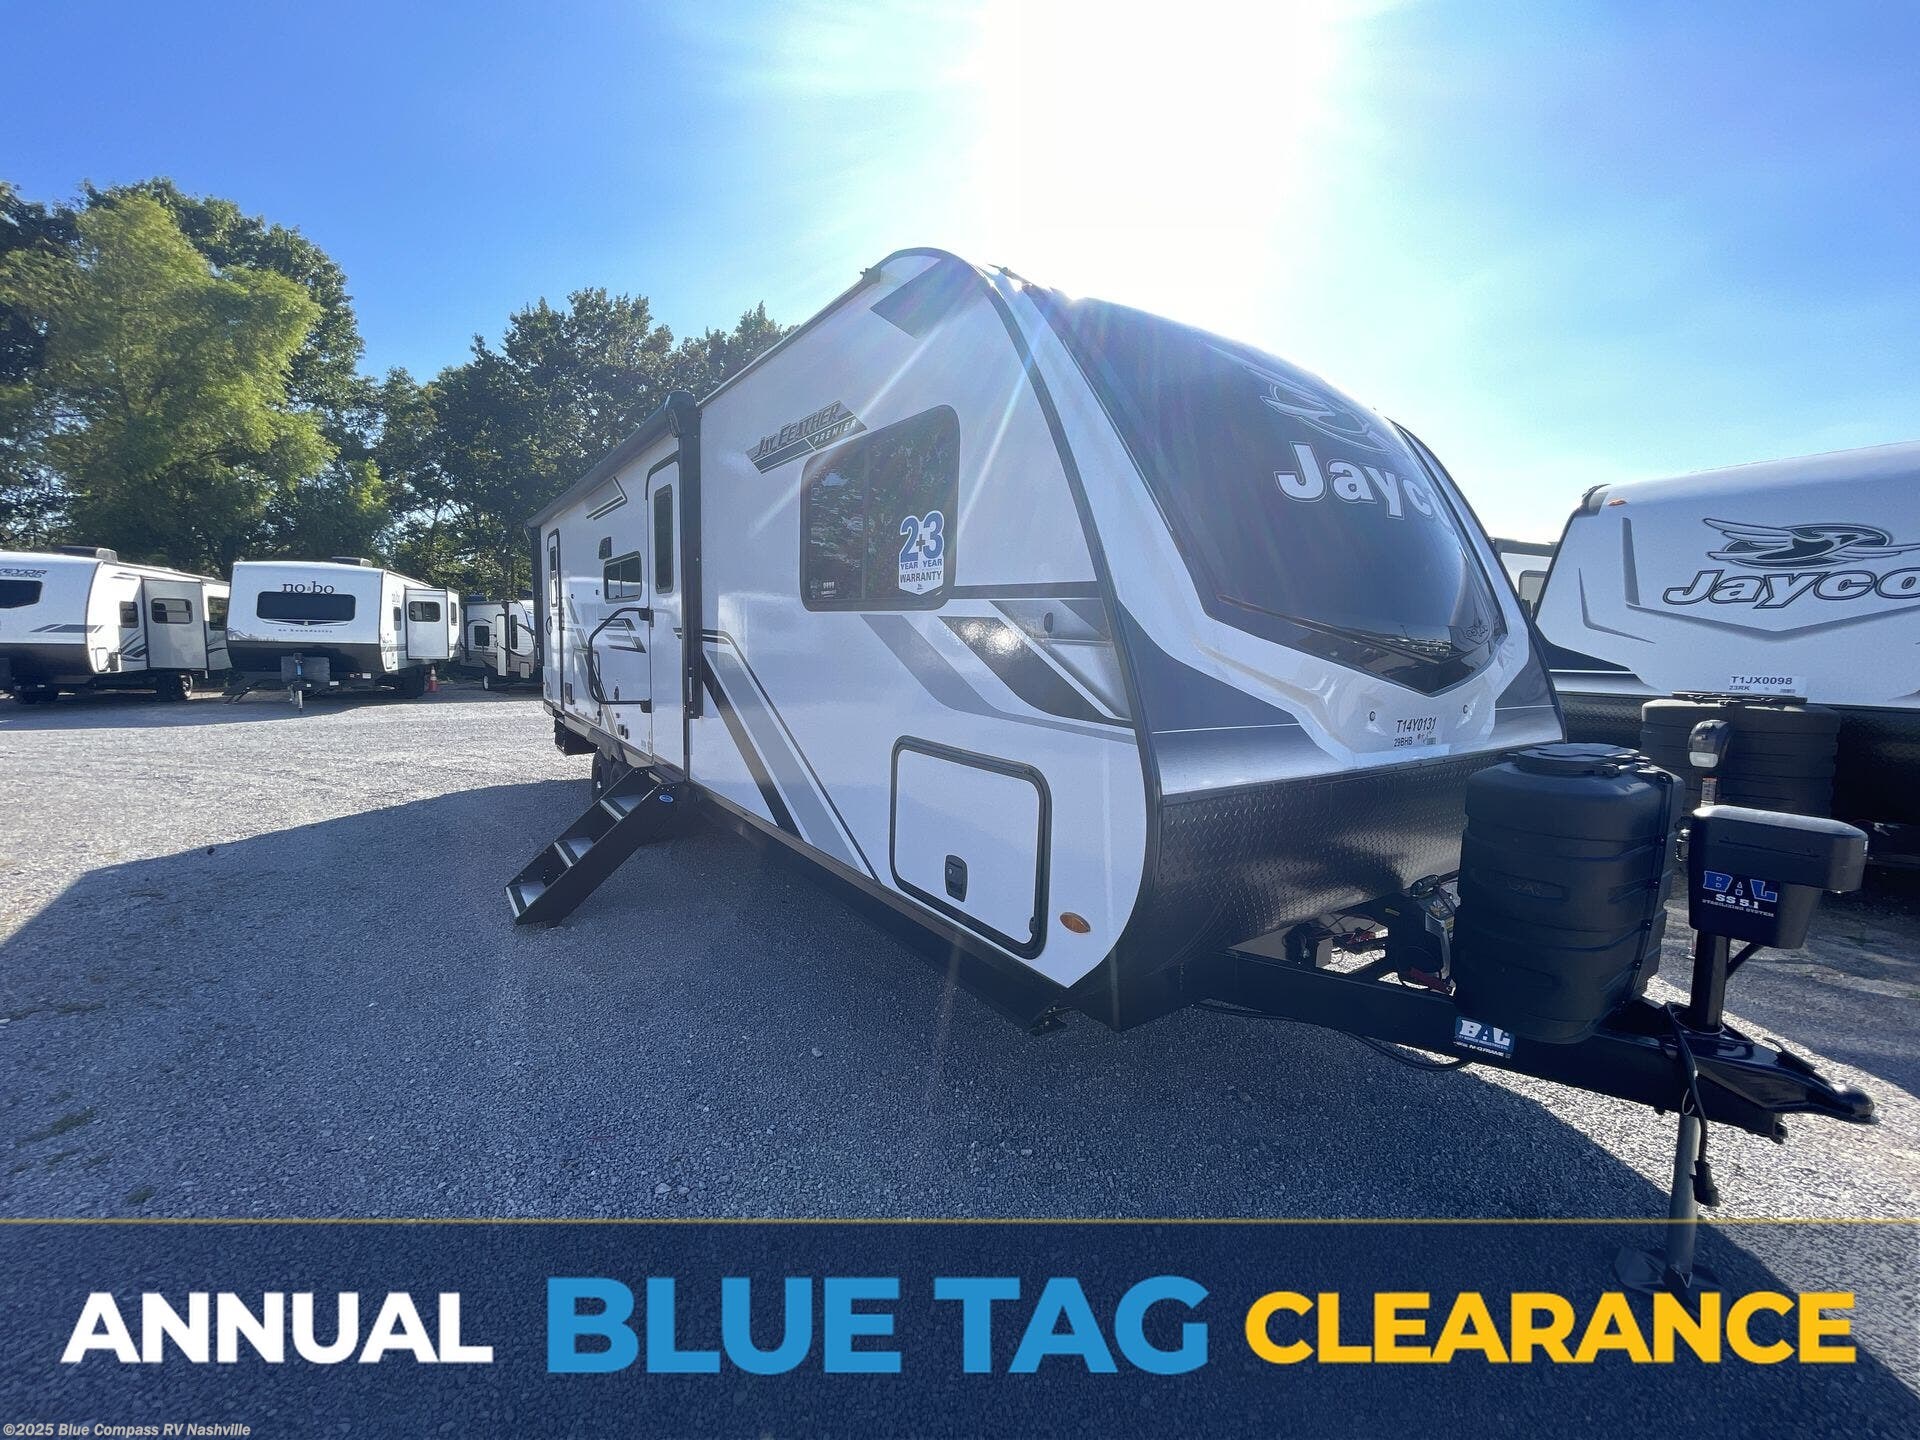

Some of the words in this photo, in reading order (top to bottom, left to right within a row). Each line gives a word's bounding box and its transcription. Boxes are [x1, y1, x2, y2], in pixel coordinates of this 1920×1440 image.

[778, 402, 842, 448] FEATHER
[812, 419, 858, 445] PREMIER
[901, 562, 919, 570] YEAR
[923, 559, 943, 568] YEAR
[901, 571, 942, 583] WARRANTY
[1731, 676, 1793, 685] T1JX0098
[1397, 717, 1437, 733] T14Y0131
[1703, 870, 1777, 902] BAL
[1716, 894, 1736, 904] SS
[1746, 907, 1775, 917] SYSTEM
[1459, 1020, 1510, 1046] BAL
